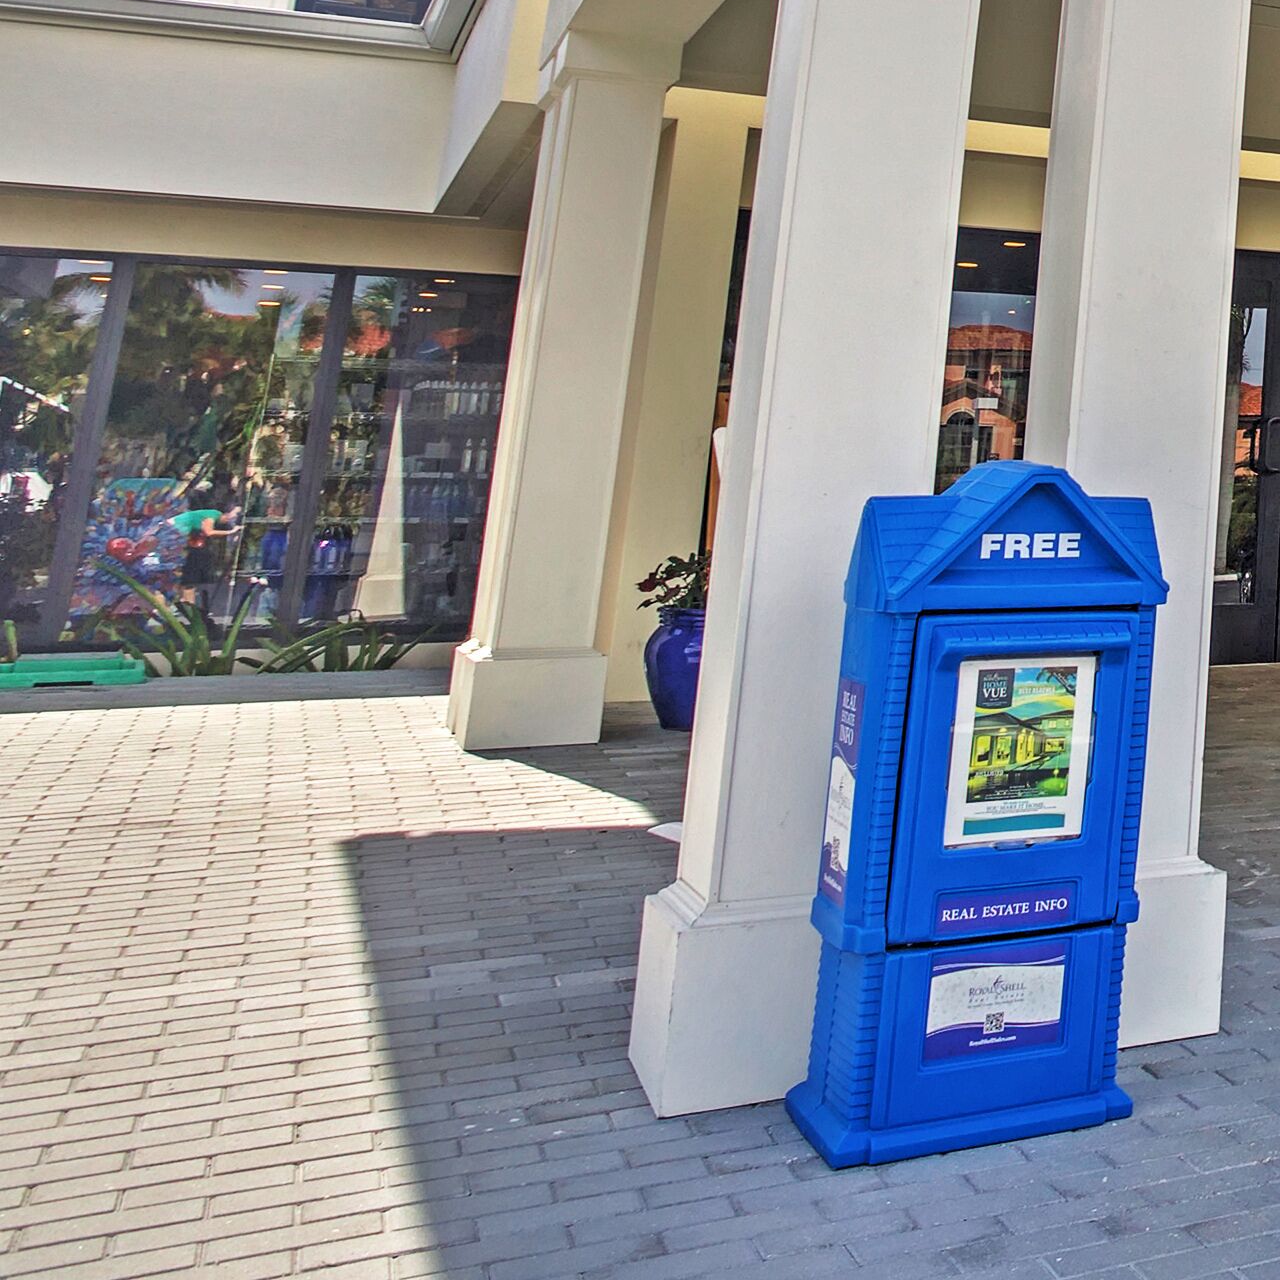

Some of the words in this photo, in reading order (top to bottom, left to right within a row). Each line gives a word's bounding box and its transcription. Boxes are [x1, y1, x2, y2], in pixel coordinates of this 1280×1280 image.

[980, 533, 1081, 559] FREE
[983, 687, 1007, 698] VUE
[941, 907, 977, 922] REAL
[982, 902, 1030, 918] ESTATE
[1034, 898, 1068, 913] INFO
